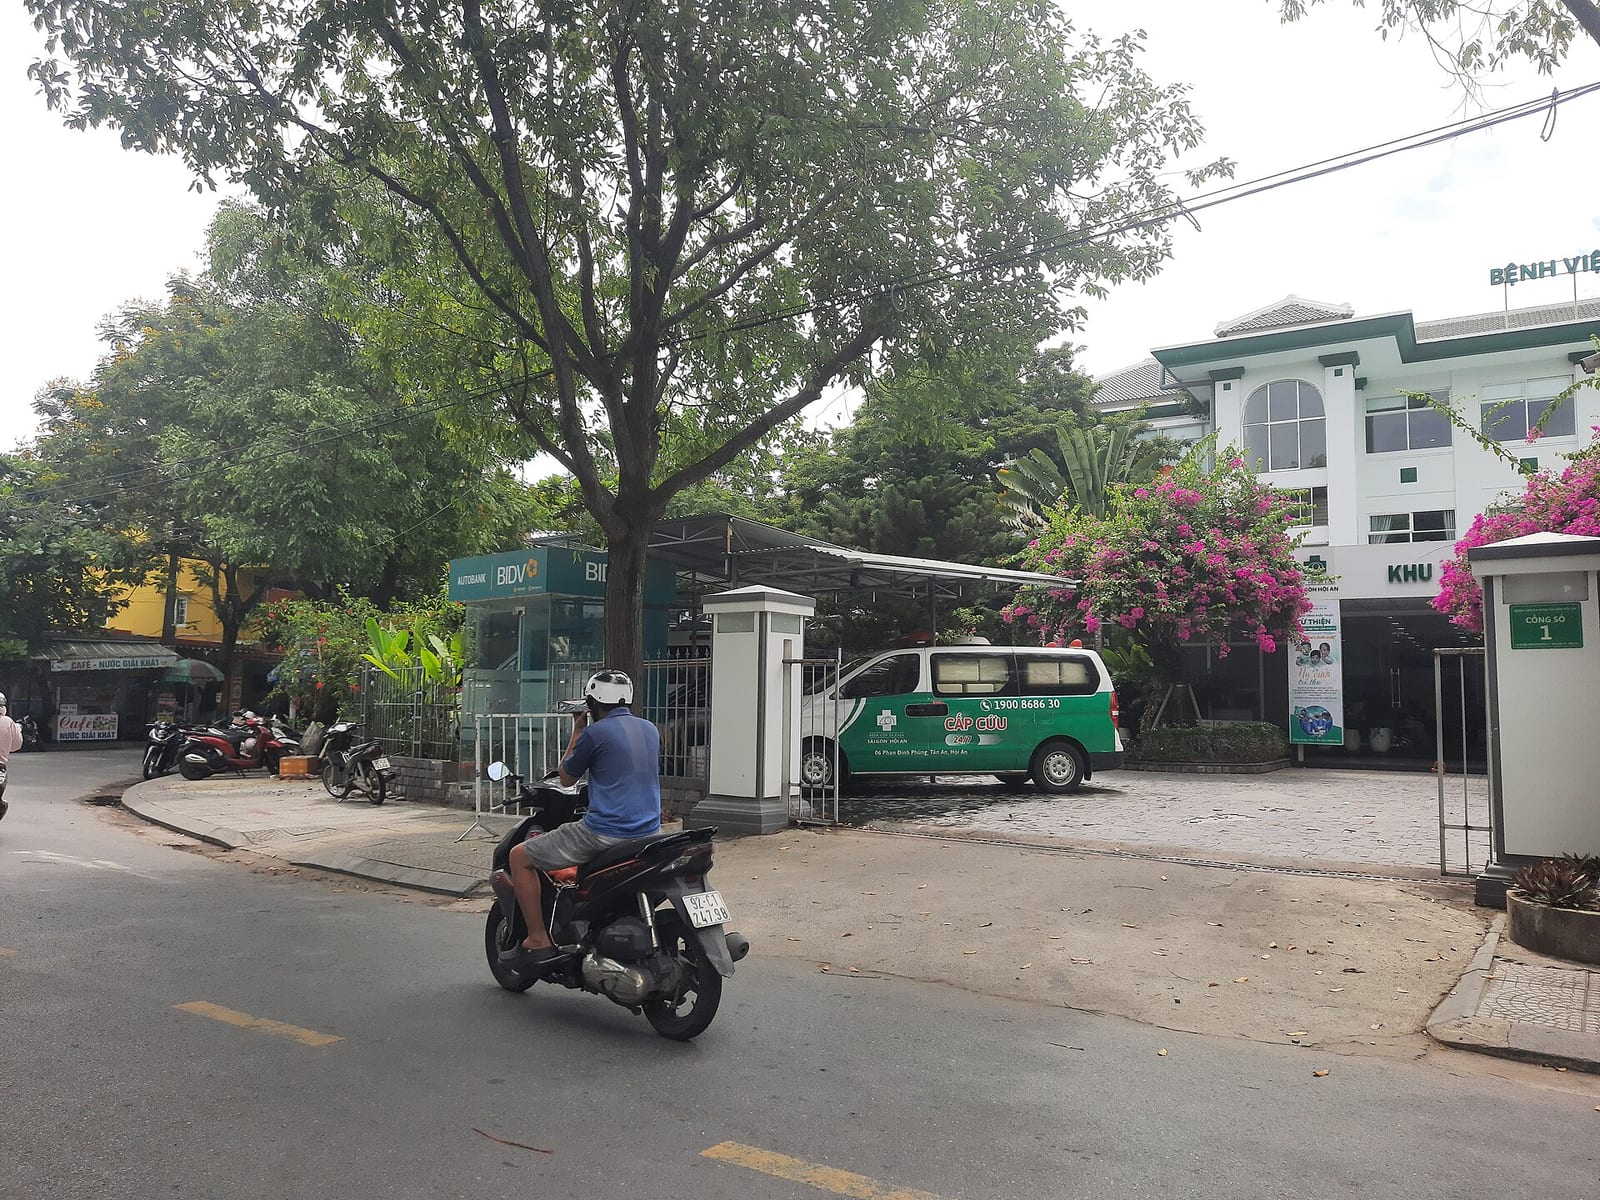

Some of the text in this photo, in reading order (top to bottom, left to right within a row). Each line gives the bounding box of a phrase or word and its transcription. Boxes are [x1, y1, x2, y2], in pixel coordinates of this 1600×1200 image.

[1490, 260, 1556, 286] BỆNH
[457, 563, 528, 586] AUTOBANK BIDV
[1388, 563, 1432, 583] KHU
[1540, 624, 1552, 640] 1
[994, 699, 1060, 710] 1900 8686 30
[944, 712, 1008, 731] CẤP CỨU
[953, 735, 972, 744] 24/7
